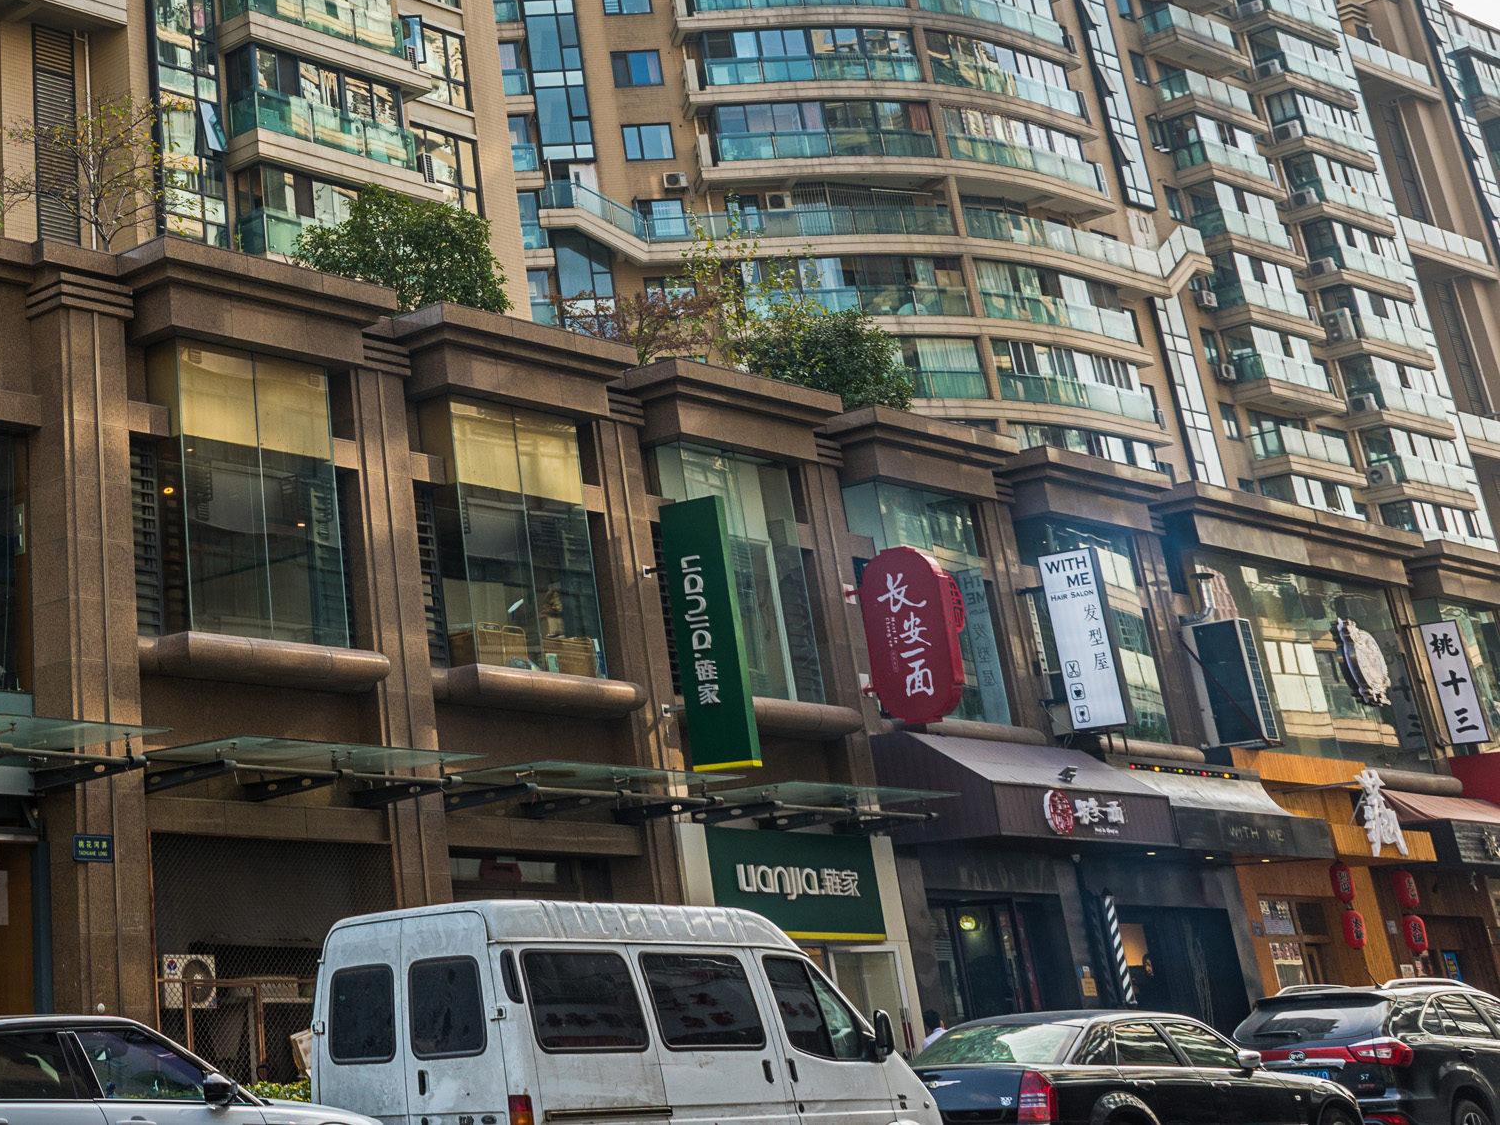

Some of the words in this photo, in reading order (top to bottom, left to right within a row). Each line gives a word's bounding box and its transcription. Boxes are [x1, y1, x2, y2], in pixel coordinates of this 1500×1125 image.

[1045, 556, 1087, 575] WITH
[1066, 572, 1092, 588] ME
[877, 573, 934, 697] 长安一面
[1083, 604, 1110, 671] 发型屋
[1429, 632, 1480, 733] 桃十三
[1228, 824, 1260, 840] WITH
[1266, 827, 1285, 842] ME
[78, 840, 107, 849] 桃花河弄
[1360, 1073, 1369, 1081] S7
